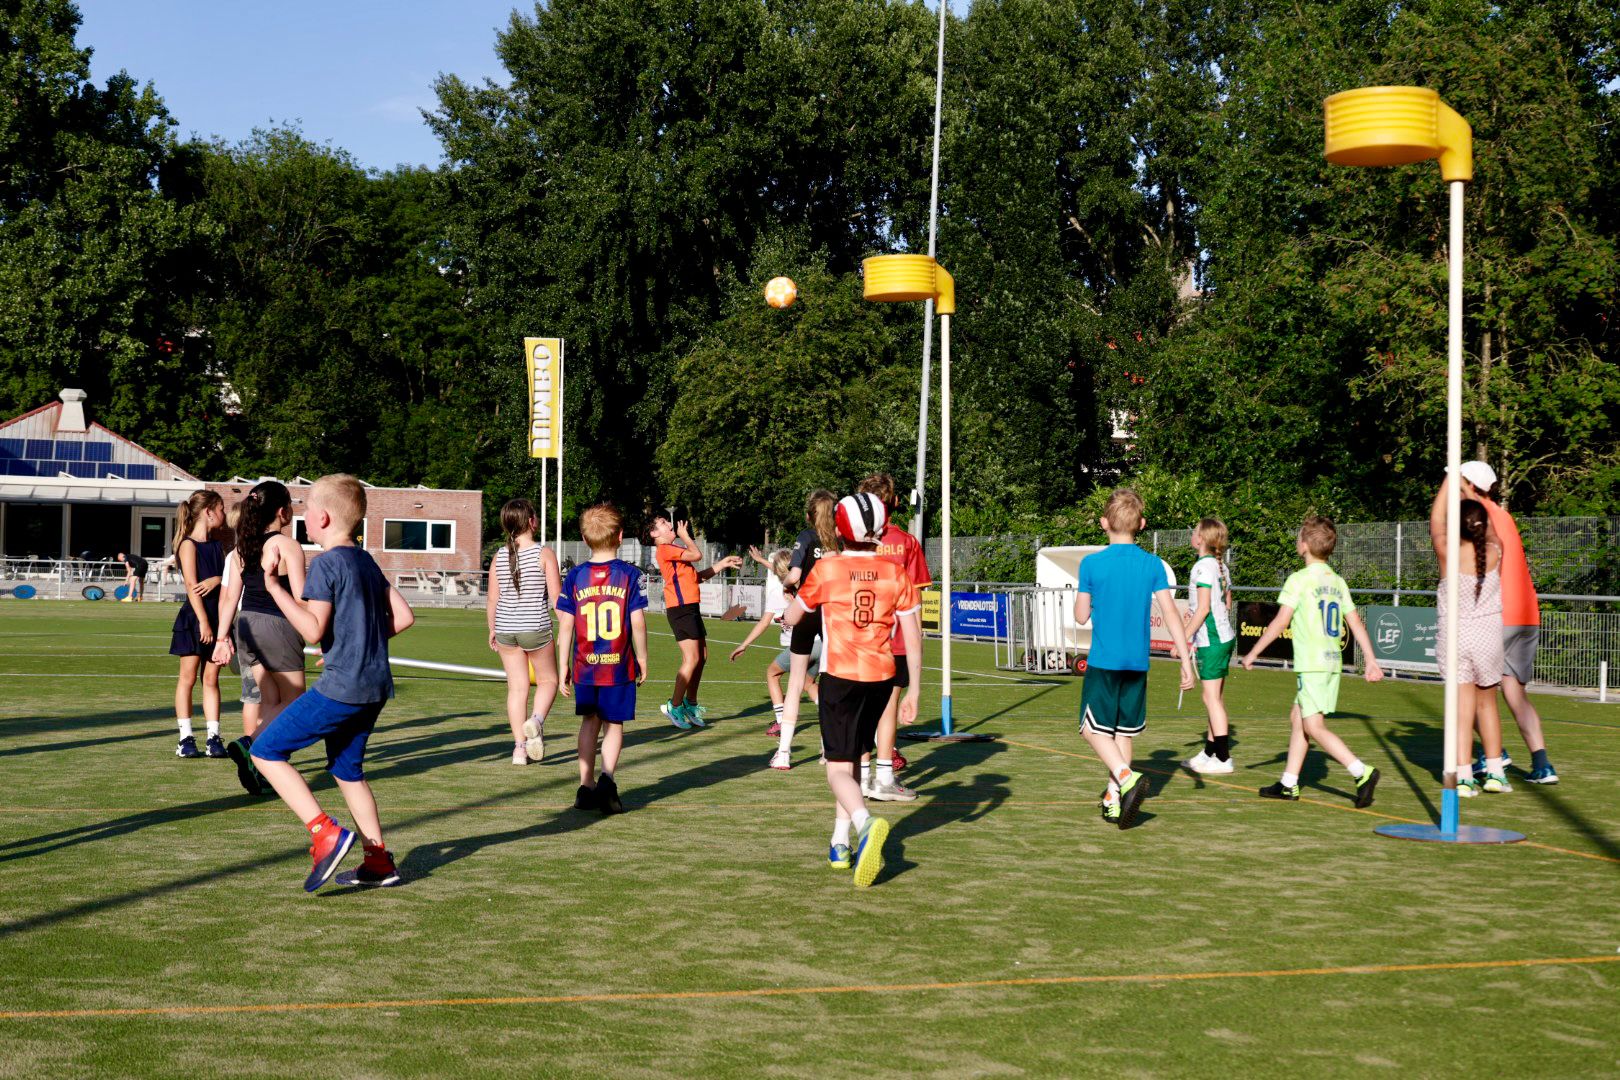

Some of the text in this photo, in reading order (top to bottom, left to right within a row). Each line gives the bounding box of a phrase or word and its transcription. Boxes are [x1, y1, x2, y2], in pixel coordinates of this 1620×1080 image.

[532, 344, 551, 449] JUMBO
[849, 570, 879, 582] WILLEM
[576, 586, 626, 601] LAMINE YAMAL
[854, 590, 876, 628] 8
[957, 600, 999, 613] VRIENDENLOTERJ
[580, 601, 622, 641] 10
[1318, 600, 1340, 637] 10
[1240, 621, 1263, 637] Scoor
[1377, 628, 1401, 644] LEF
